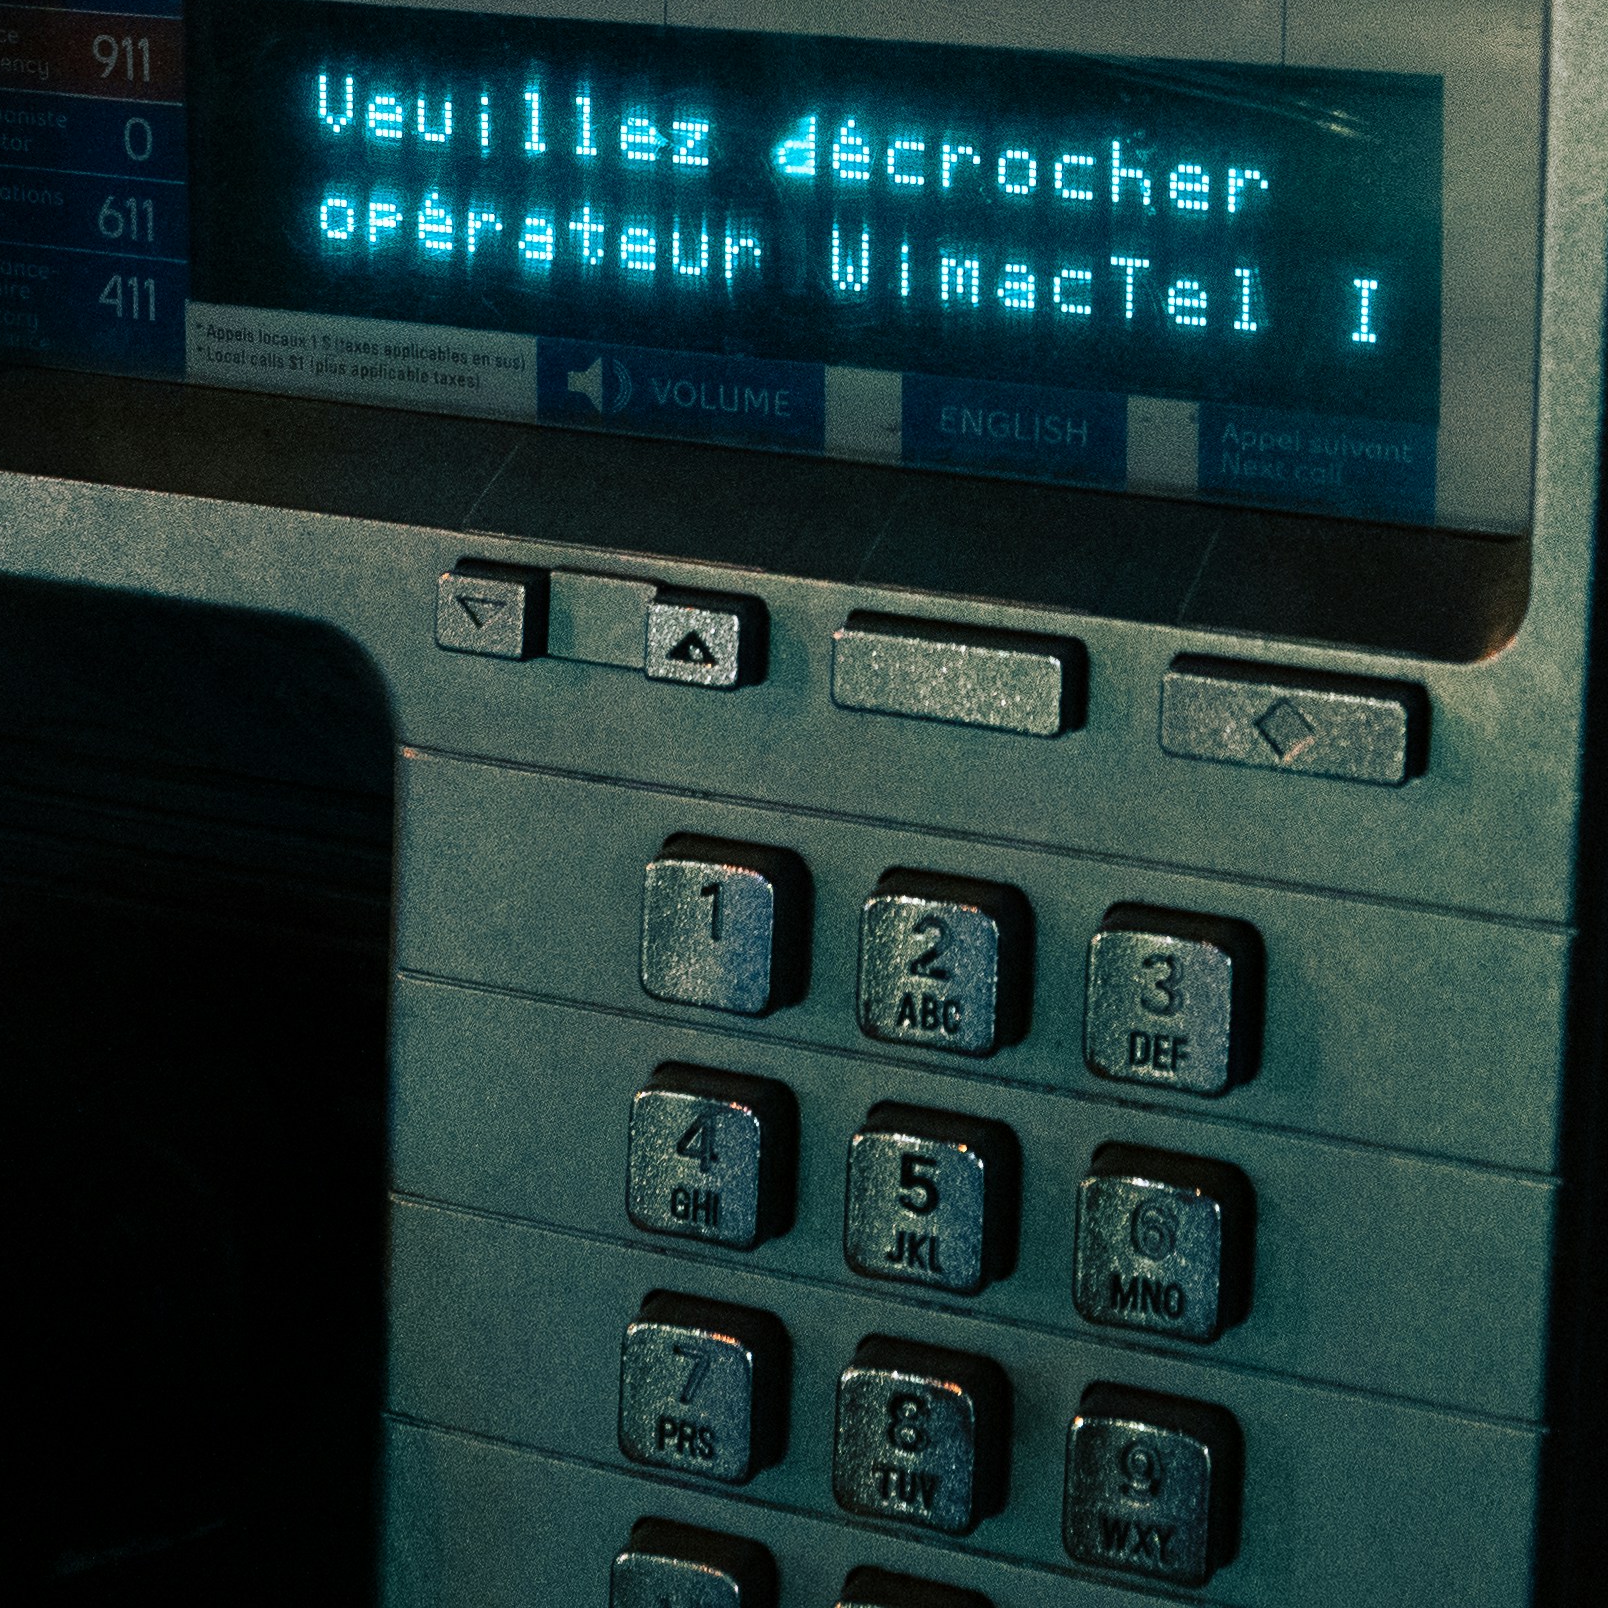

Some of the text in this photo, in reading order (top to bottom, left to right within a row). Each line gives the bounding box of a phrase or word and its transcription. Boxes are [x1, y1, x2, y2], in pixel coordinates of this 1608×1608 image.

[92, 33, 151, 83] 911
[123, 116, 154, 162] 0
[317, 71, 1268, 213] Veuillez décrocher
[97, 195, 155, 242] 611
[319, 192, 1379, 343] opérateur WimacTel I
[97, 273, 156, 323] 411
[206, 324, 526, 372] Appels locaux applicables en sus)
[251, 350, 285, 368] calls
[351, 358, 427, 384] applicable
[432, 371, 480, 391] taxes)
[649, 375, 791, 420] VOLUME
[940, 405, 1089, 446] ENGLISH
[1221, 422, 1414, 465] Appel suivant
[1221, 452, 1345, 486] Next call
[698, 880, 723, 943] 1
[909, 914, 952, 982] 2
[1140, 953, 1186, 1018] 3
[895, 991, 963, 1039] ABC
[1125, 1030, 1190, 1074] DEF
[676, 1113, 717, 1175] 4
[898, 1153, 939, 1215] 5
[670, 1188, 720, 1229] GHI
[1129, 1197, 1179, 1263] 6
[886, 1232, 943, 1275] JKL
[1109, 1275, 1185, 1320] MNO
[672, 1344, 712, 1406] 7
[657, 1419, 714, 1462] PRS
[889, 1393, 931, 1452] 8
[1117, 1438, 1166, 1498] 9
[1099, 1516, 1177, 1558] WXY
